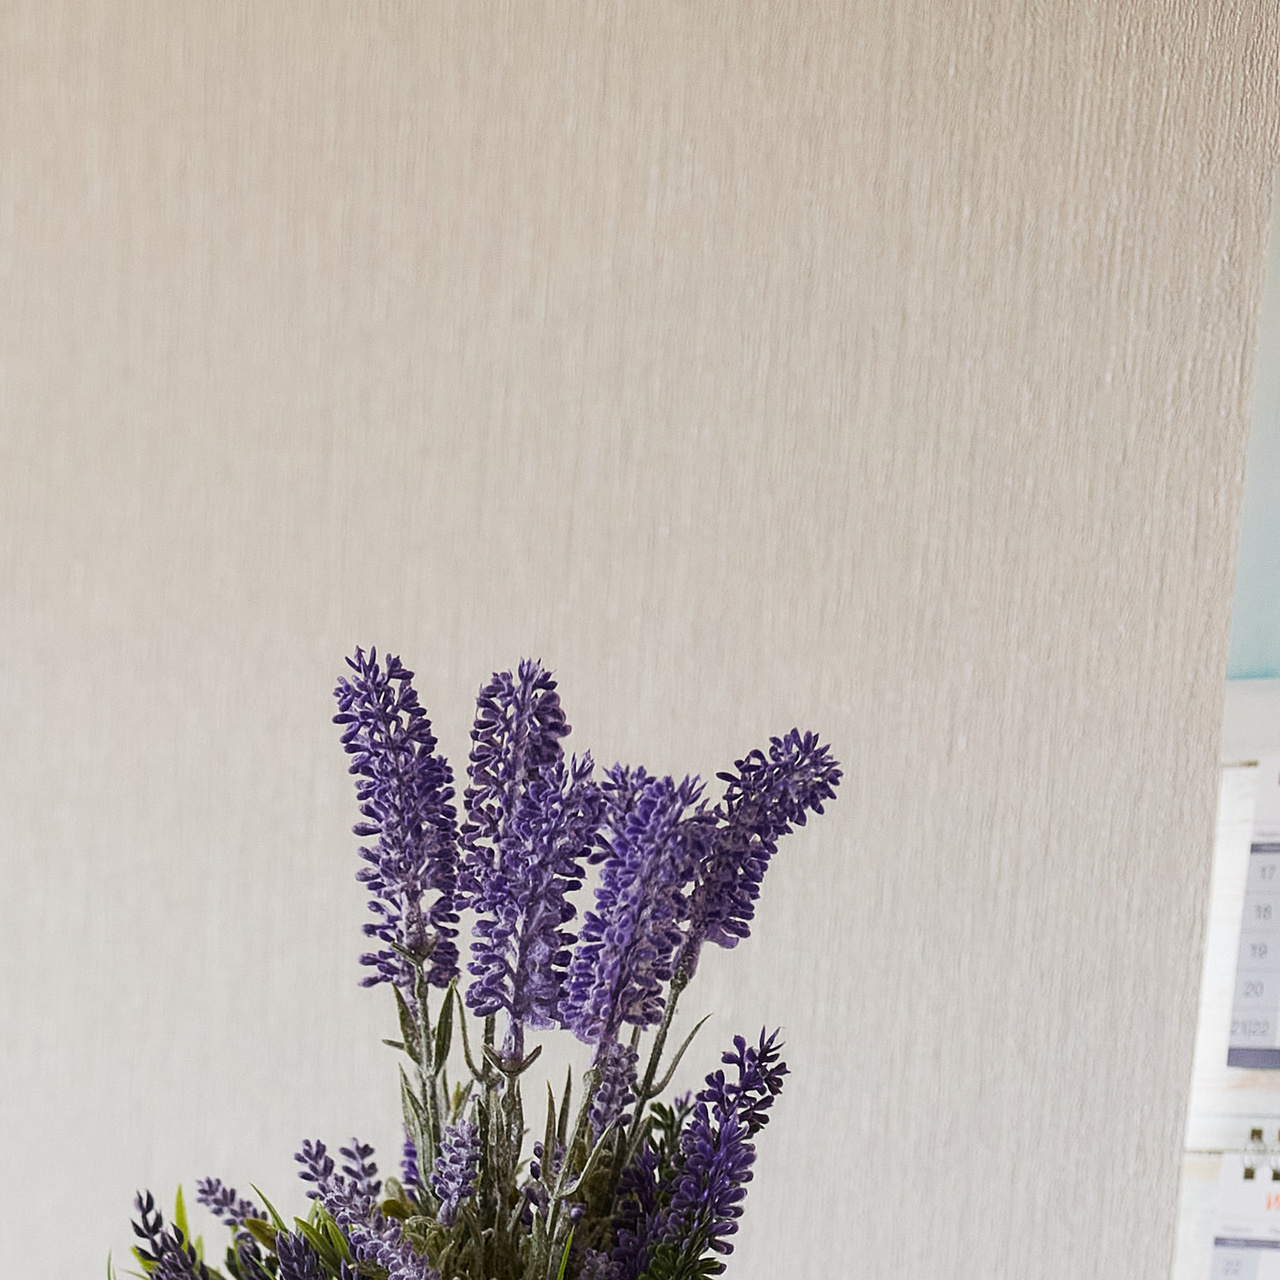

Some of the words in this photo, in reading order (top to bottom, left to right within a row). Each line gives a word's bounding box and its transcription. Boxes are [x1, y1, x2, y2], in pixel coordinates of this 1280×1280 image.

[1260, 864, 1277, 881] 17
[1255, 903, 1273, 920] 18
[1250, 943, 1268, 960] 19
[1243, 981, 1265, 998] 20
